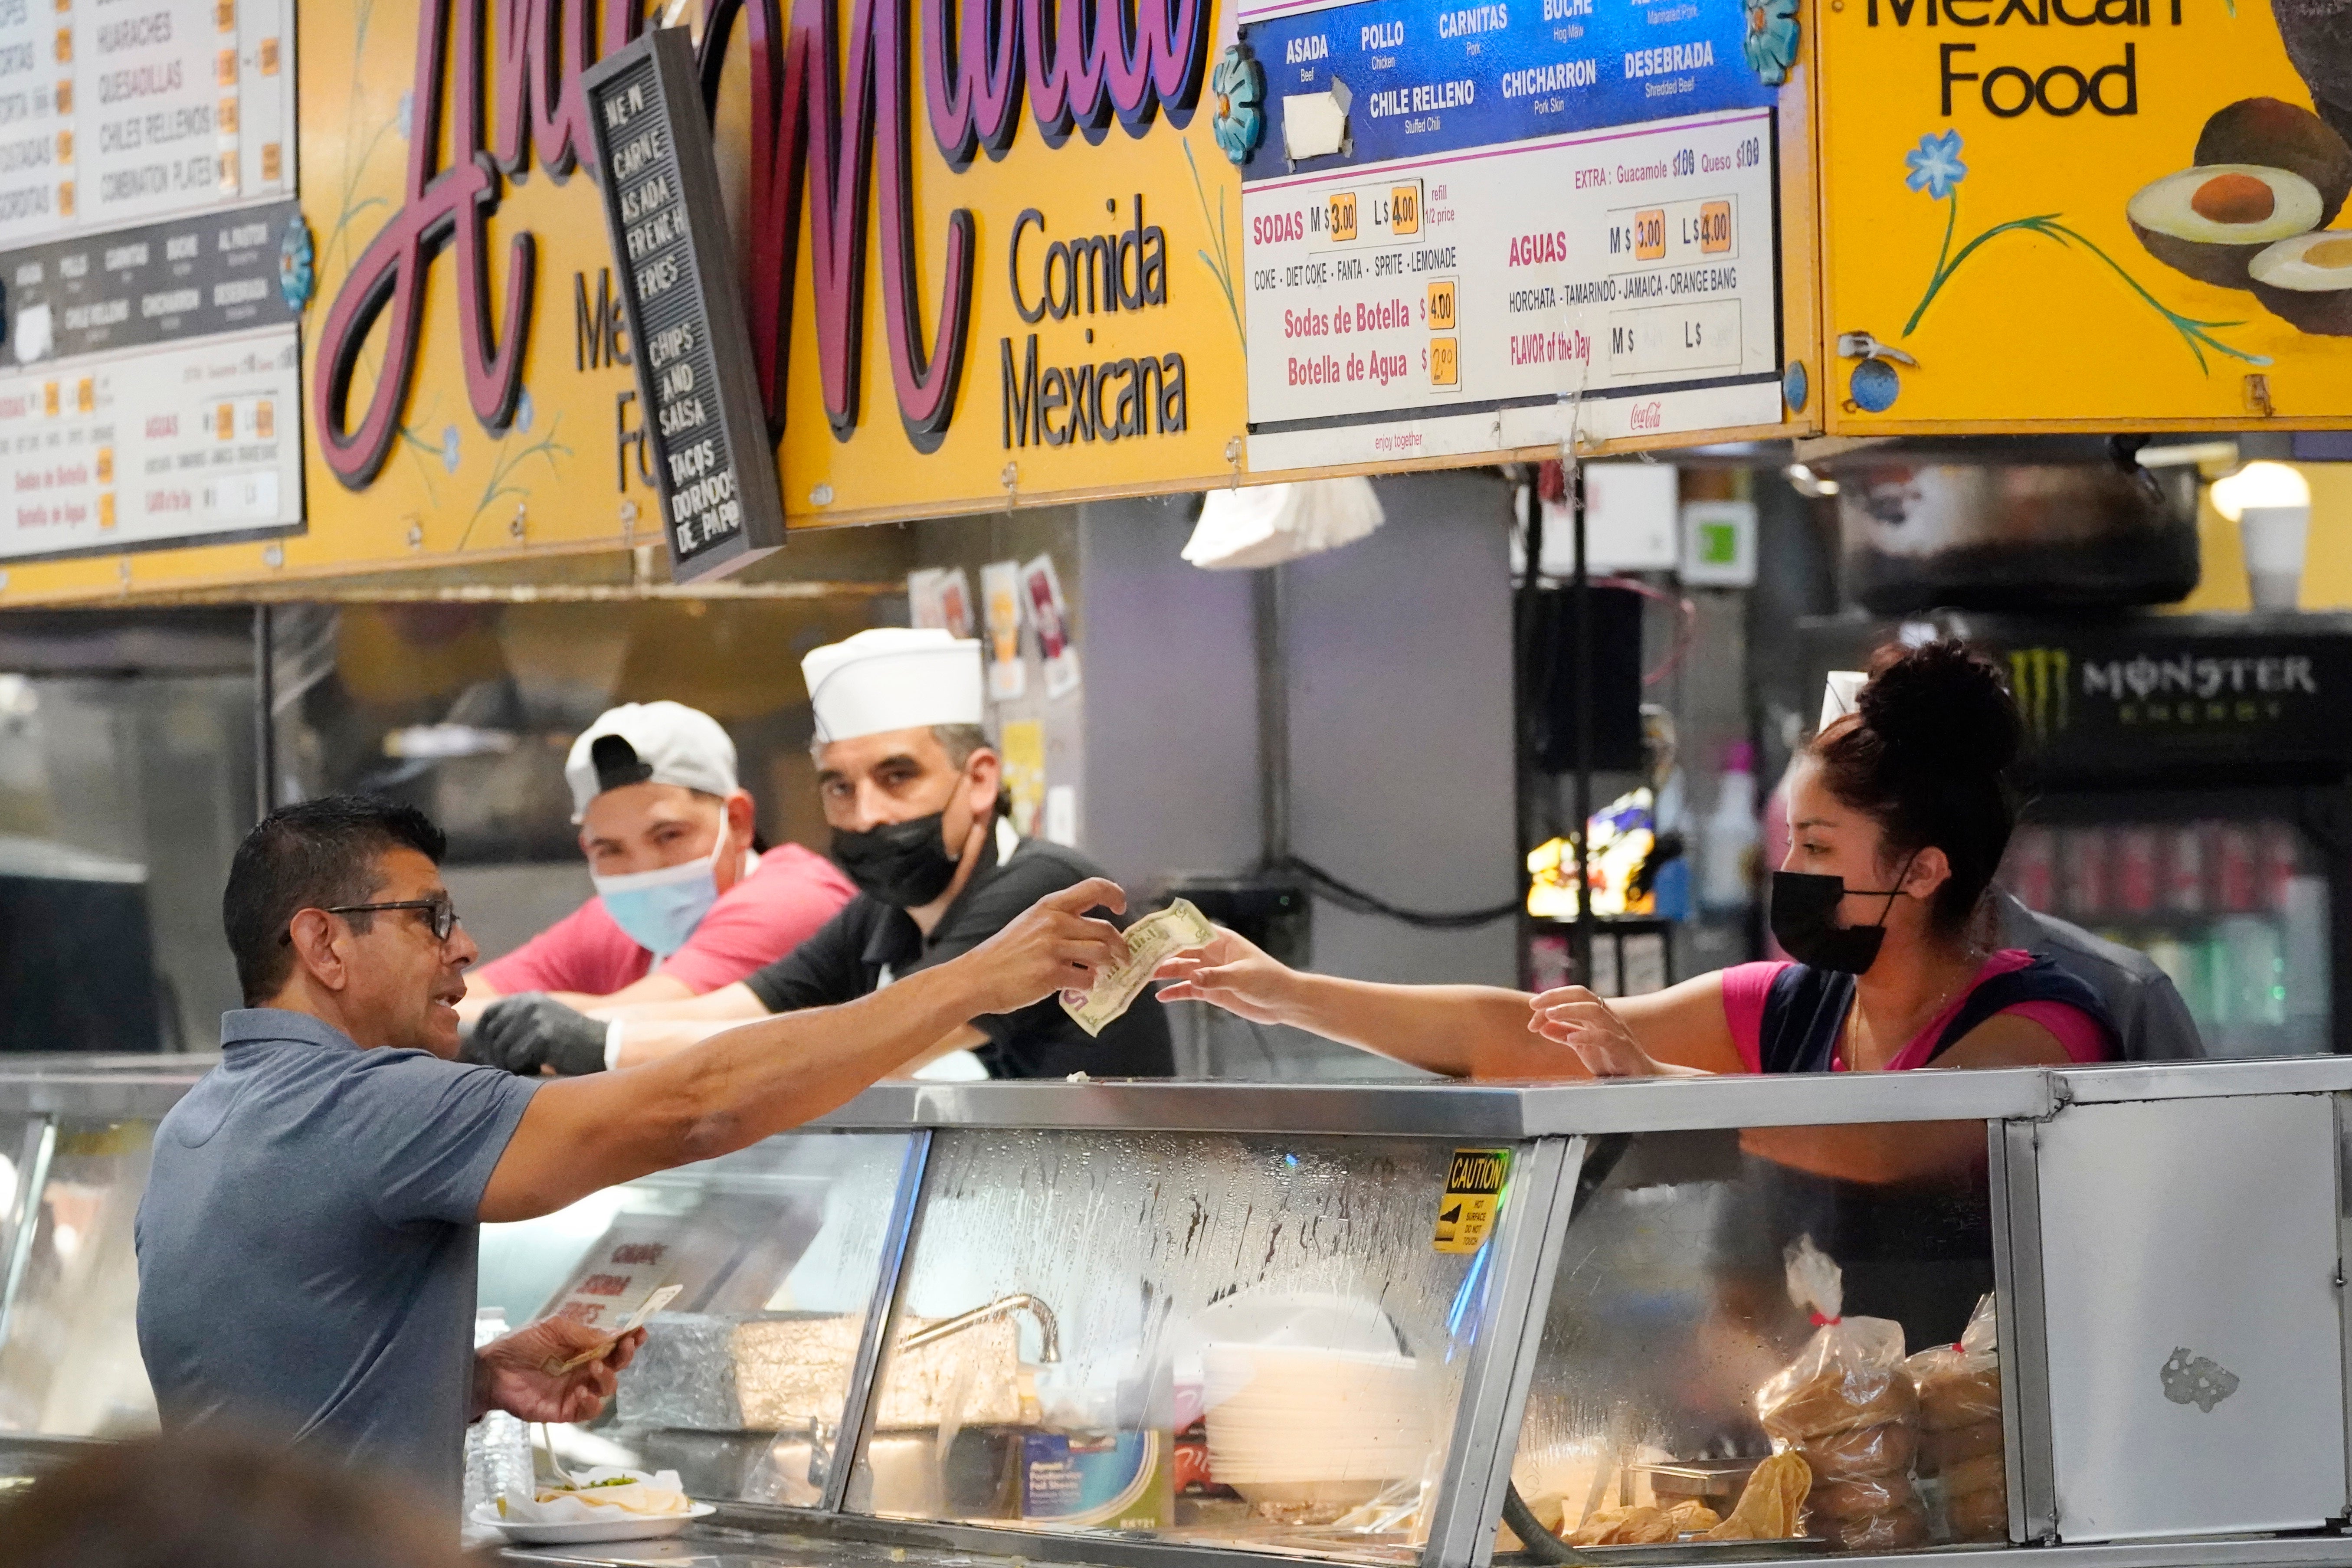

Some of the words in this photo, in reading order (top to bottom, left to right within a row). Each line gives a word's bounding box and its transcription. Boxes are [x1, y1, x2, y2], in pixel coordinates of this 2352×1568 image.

[1439, 3, 1507, 38] CARNITAS
[1544, 0, 1592, 21] BUCHE
[1287, 35, 1328, 64] ASADA
[1362, 21, 1404, 50] POLLO
[1467, 42, 1481, 56] Pork
[1553, 27, 1567, 43] Hog
[1569, 25, 1583, 39] Maw
[1301, 69, 1314, 82] Beef
[1372, 56, 1395, 71] Chicken
[1625, 41, 1713, 79] DESEBRADA
[1502, 59, 1596, 98] CHICHARRON
[1645, 79, 1677, 98] Shredded
[1679, 77, 1694, 92] Beef
[1940, 42, 2137, 117] Food
[1370, 88, 1409, 118] CHILE
[1413, 79, 1474, 112] RELLENO
[1534, 100, 1548, 115] Pork
[1550, 97, 1564, 112] Skin
[1405, 118, 1425, 134] Stuffed
[1427, 116, 1440, 130] Chili
[614, 131, 663, 179] CARNE
[1617, 160, 1667, 184] Guacamole
[1702, 154, 1731, 173] Queso
[622, 175, 670, 223] ASADA
[1432, 185, 1447, 201] refill
[627, 207, 685, 260] FRENCH
[1254, 211, 1303, 245] SODAS
[1425, 208, 1434, 224] 1/2
[1437, 208, 1454, 226] price
[1009, 193, 1167, 324] Comida
[1510, 231, 1566, 267] AGUAS
[637, 256, 678, 301] FRIES
[1255, 269, 1275, 291] COKE
[1287, 266, 1303, 287] DIET
[1306, 263, 1327, 285] COKE
[1337, 259, 1362, 281] FANTA
[1375, 253, 1402, 277] SPRITE
[1412, 247, 1456, 272] LEMONADE
[1510, 287, 1556, 313] HORCHATA
[1565, 278, 1615, 306] TAMARINDO
[1624, 274, 1662, 300] JAMAICA
[1670, 268, 1708, 294] ORANGE
[1711, 267, 1736, 291] BANG
[1285, 308, 1328, 338] Sodas
[1333, 305, 1351, 334] de
[1357, 299, 1409, 332] Botella
[649, 323, 694, 368] CHIPS
[1511, 333, 1545, 366] FLAVOR
[1547, 331, 1555, 361] of
[1558, 331, 1572, 361] the
[1575, 330, 1590, 366] Day
[1613, 327, 1623, 354] M
[1686, 321, 1693, 348] L
[663, 363, 694, 402] AND
[1289, 355, 1340, 386] Botella
[1346, 353, 1363, 381] de
[1369, 350, 1407, 386] Agua
[1000, 328, 1187, 449] Mexicana
[659, 399, 706, 436] SALSA
[1375, 435, 1392, 451] enjoy
[1394, 432, 1422, 449] together
[668, 439, 714, 487] TACOS
[677, 521, 698, 553] DE
[2082, 653, 2317, 700] MONSTER
[1451, 1158, 1503, 1189] CAUTION
[1466, 1213, 1486, 1221] SURFACE
[1463, 1237, 1478, 1245] TOUCH
